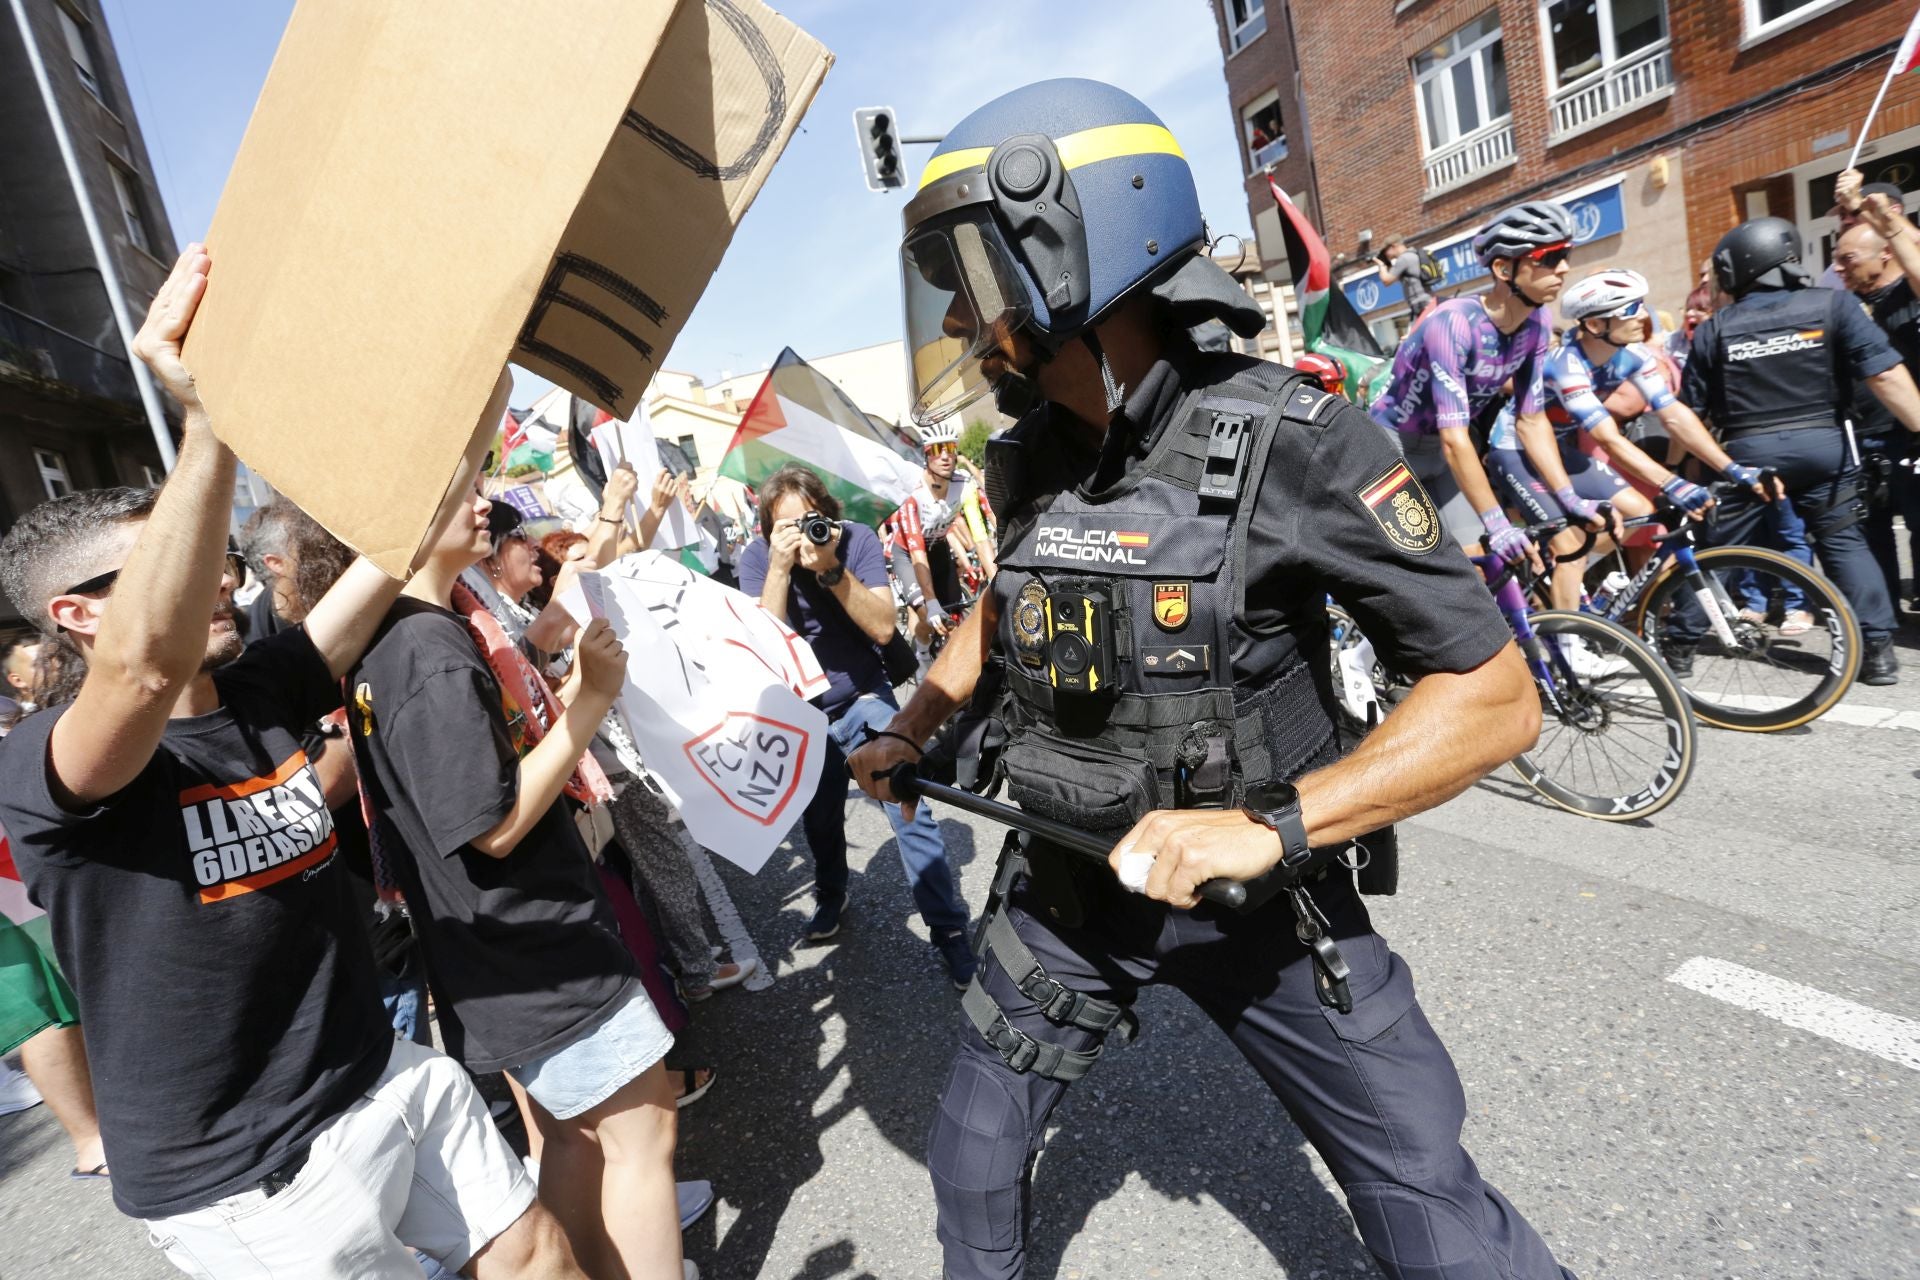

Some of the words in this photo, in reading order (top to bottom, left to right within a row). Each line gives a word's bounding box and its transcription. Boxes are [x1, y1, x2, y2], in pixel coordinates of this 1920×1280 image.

[1727, 333, 1803, 354] POLICIA
[1728, 340, 1824, 362] NACIONAL
[1393, 367, 1430, 424] Jayco
[1037, 527, 1121, 546] POLICIA
[1384, 520, 1424, 547] POLICIA
[1035, 542, 1147, 565] NACIONAL
[737, 731, 800, 808] NZS
[1608, 716, 1684, 815] CADEX
